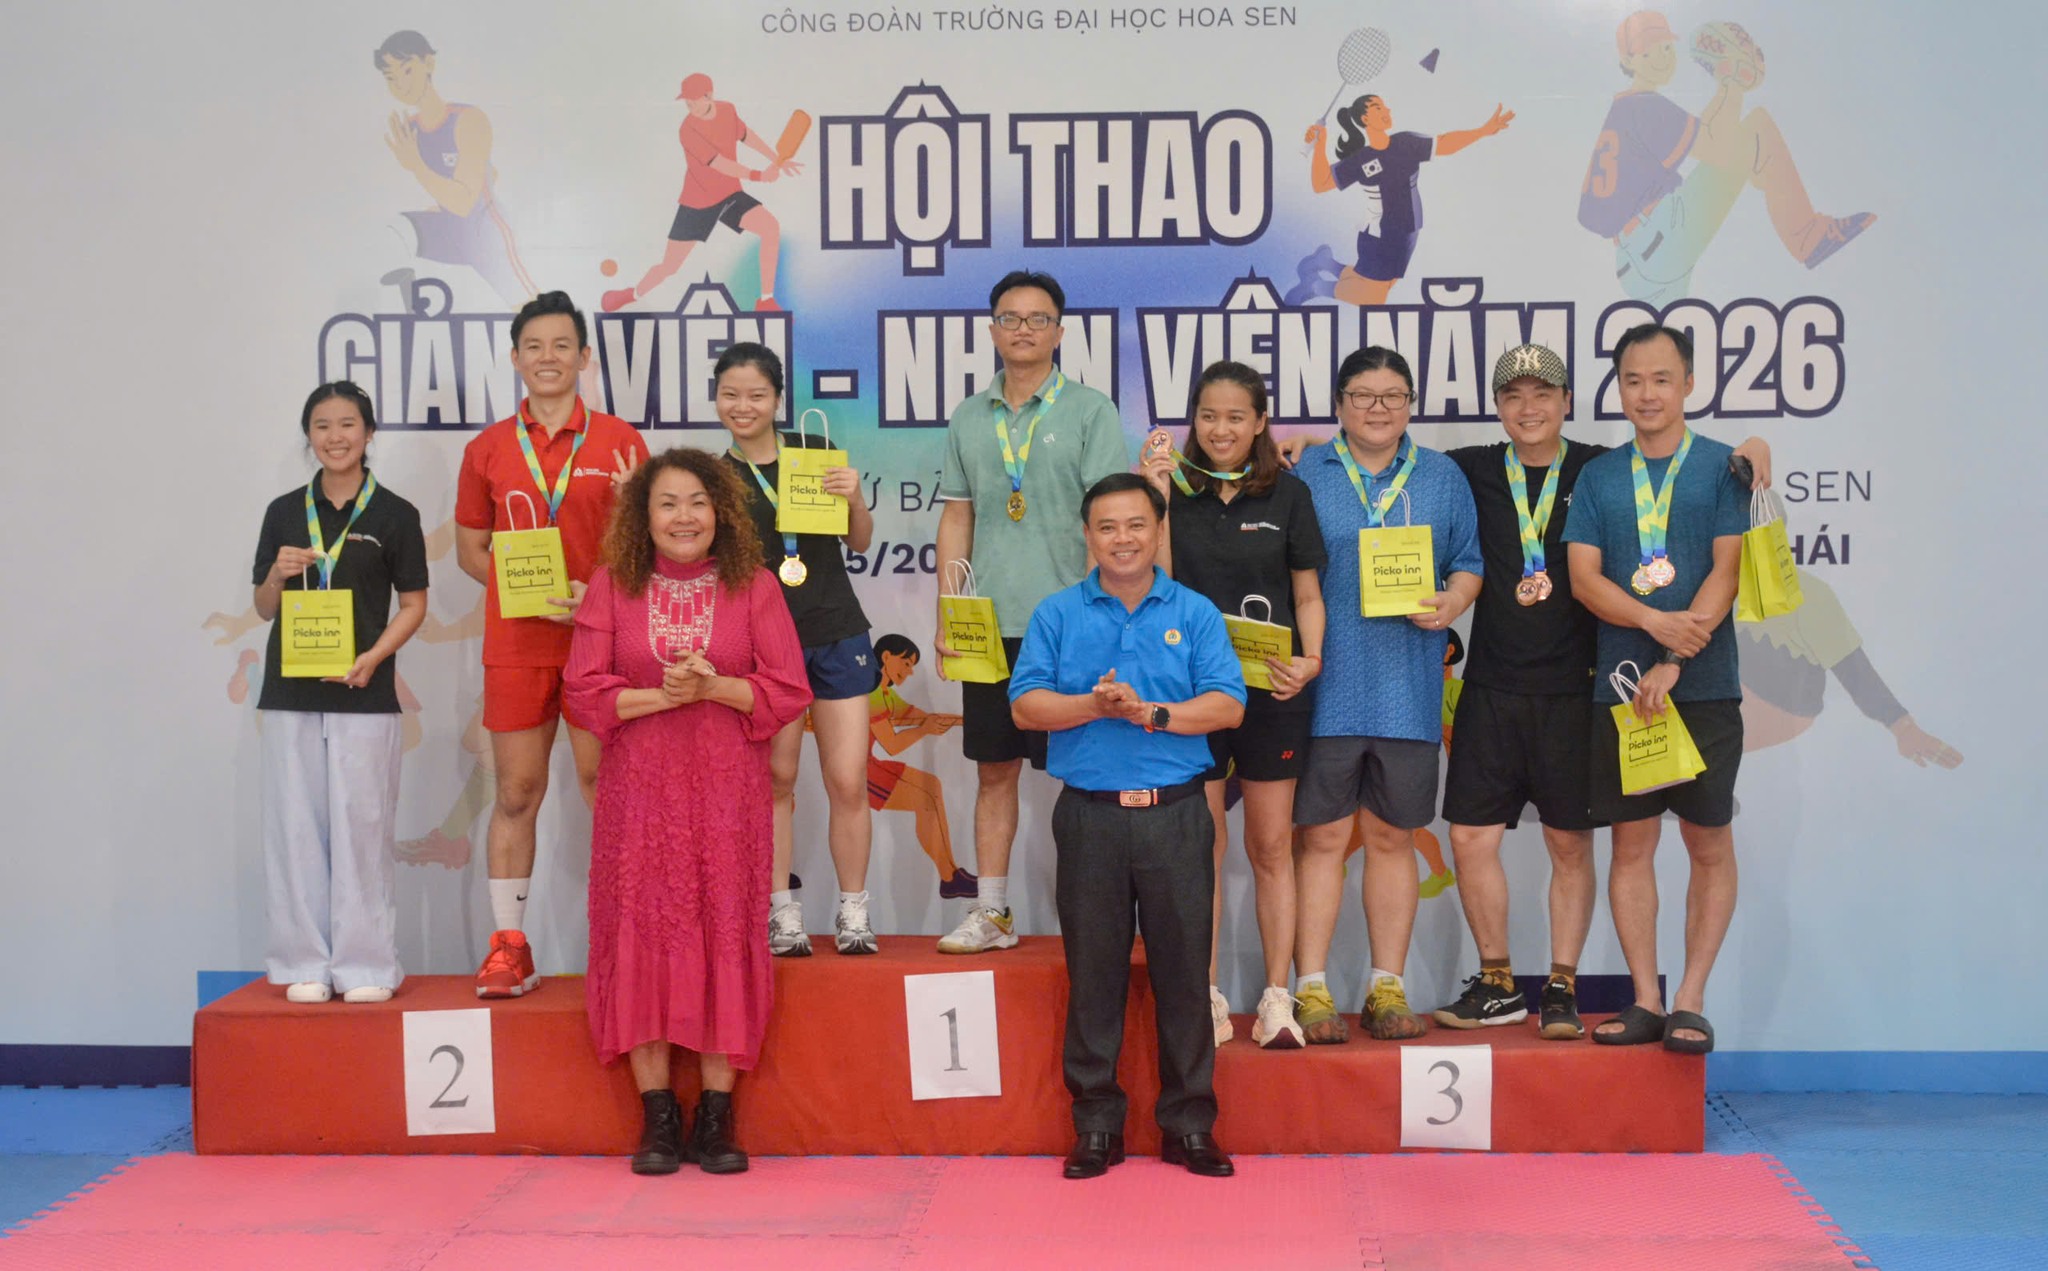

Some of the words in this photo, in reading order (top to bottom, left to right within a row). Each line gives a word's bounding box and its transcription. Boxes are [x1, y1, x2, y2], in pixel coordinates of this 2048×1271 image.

[761, 8, 837, 33] CÔNG
[846, 6, 922, 32] ĐOÀN
[933, 4, 1044, 31] TRƯỜNG
[1054, 9, 1098, 34] ĐẠI
[1110, 8, 1167, 34] HỌC
[1178, 7, 1234, 27] HOA
[1244, 6, 1297, 27] SEN
[820, 78, 991, 276] HỘI
[1009, 109, 1273, 247] THAO
[1583, 129, 1619, 198] 3
[318, 277, 580, 431] GIẢN
[877, 267, 1119, 428] NHN
[789, 485, 818, 495] Picko
[1784, 470, 1872, 503] SEN
[506, 567, 535, 578] Picko
[1373, 566, 1403, 576] Picko
[1404, 564, 1422, 575] inn
[293, 627, 322, 638] Picko
[952, 631, 974, 641] Picko
[1628, 739, 1652, 751] Picko
[938, 1006, 969, 1072] 1
[428, 1044, 470, 1109] 2
[1425, 1059, 1463, 1126] 3
